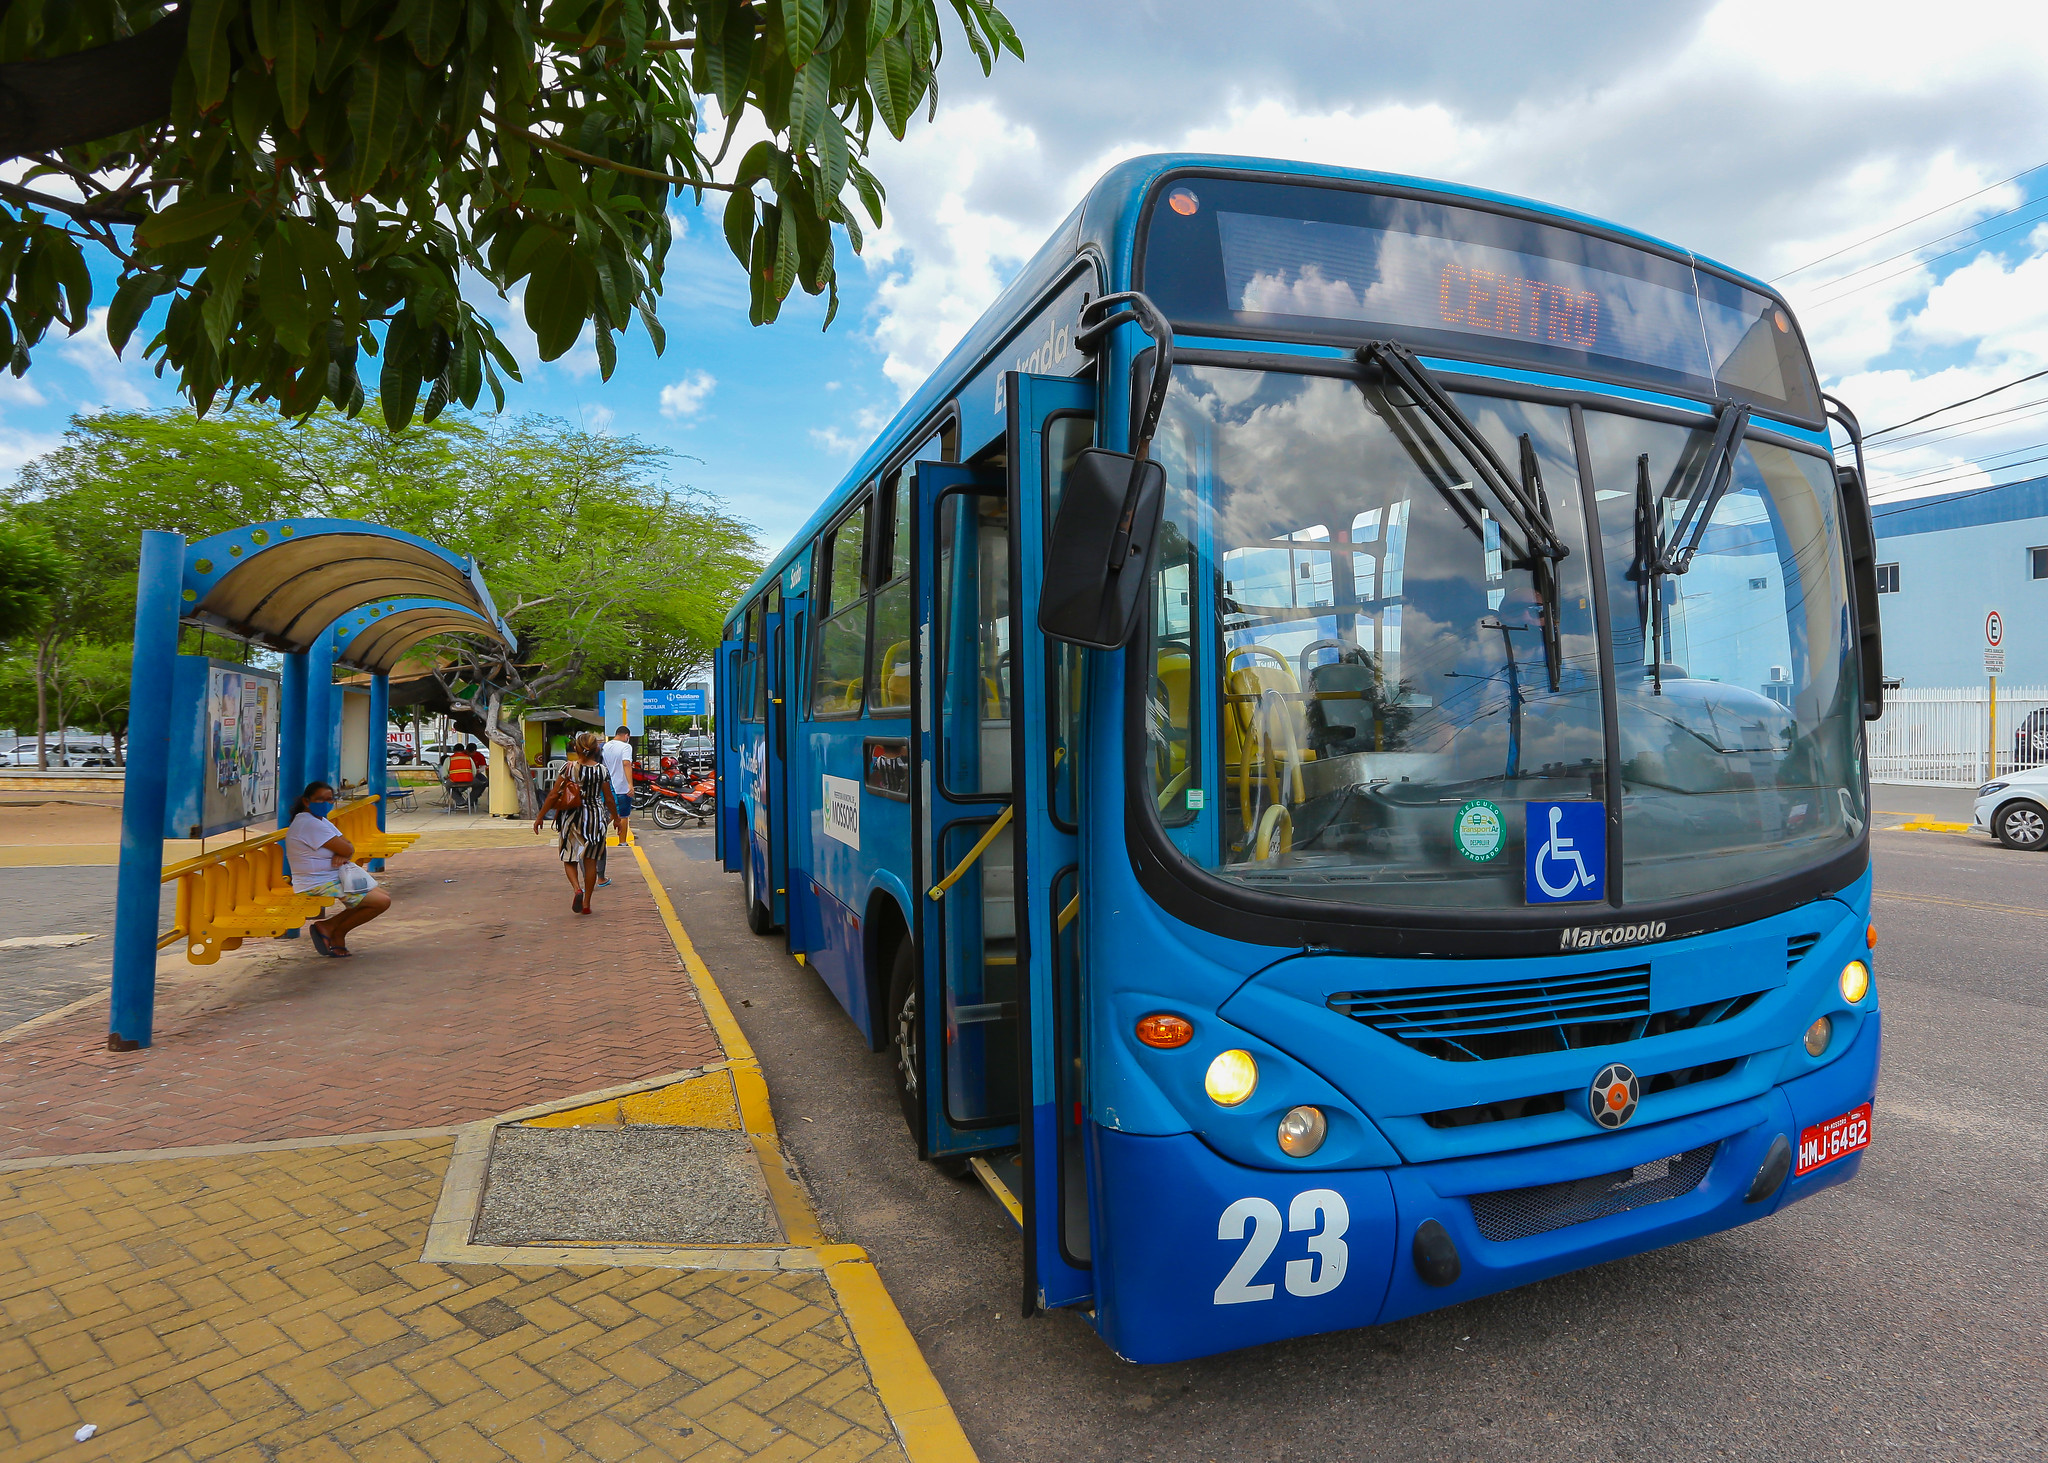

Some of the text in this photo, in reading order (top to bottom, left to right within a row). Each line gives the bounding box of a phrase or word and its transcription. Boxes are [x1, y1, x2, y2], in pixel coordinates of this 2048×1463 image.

[1440, 263, 1599, 346] CENTRO
[1991, 618, 1998, 639] E
[1460, 846, 1499, 861] APROVADO
[1560, 921, 1667, 948] Marcopolo
[1213, 1188, 1350, 1305] 23
